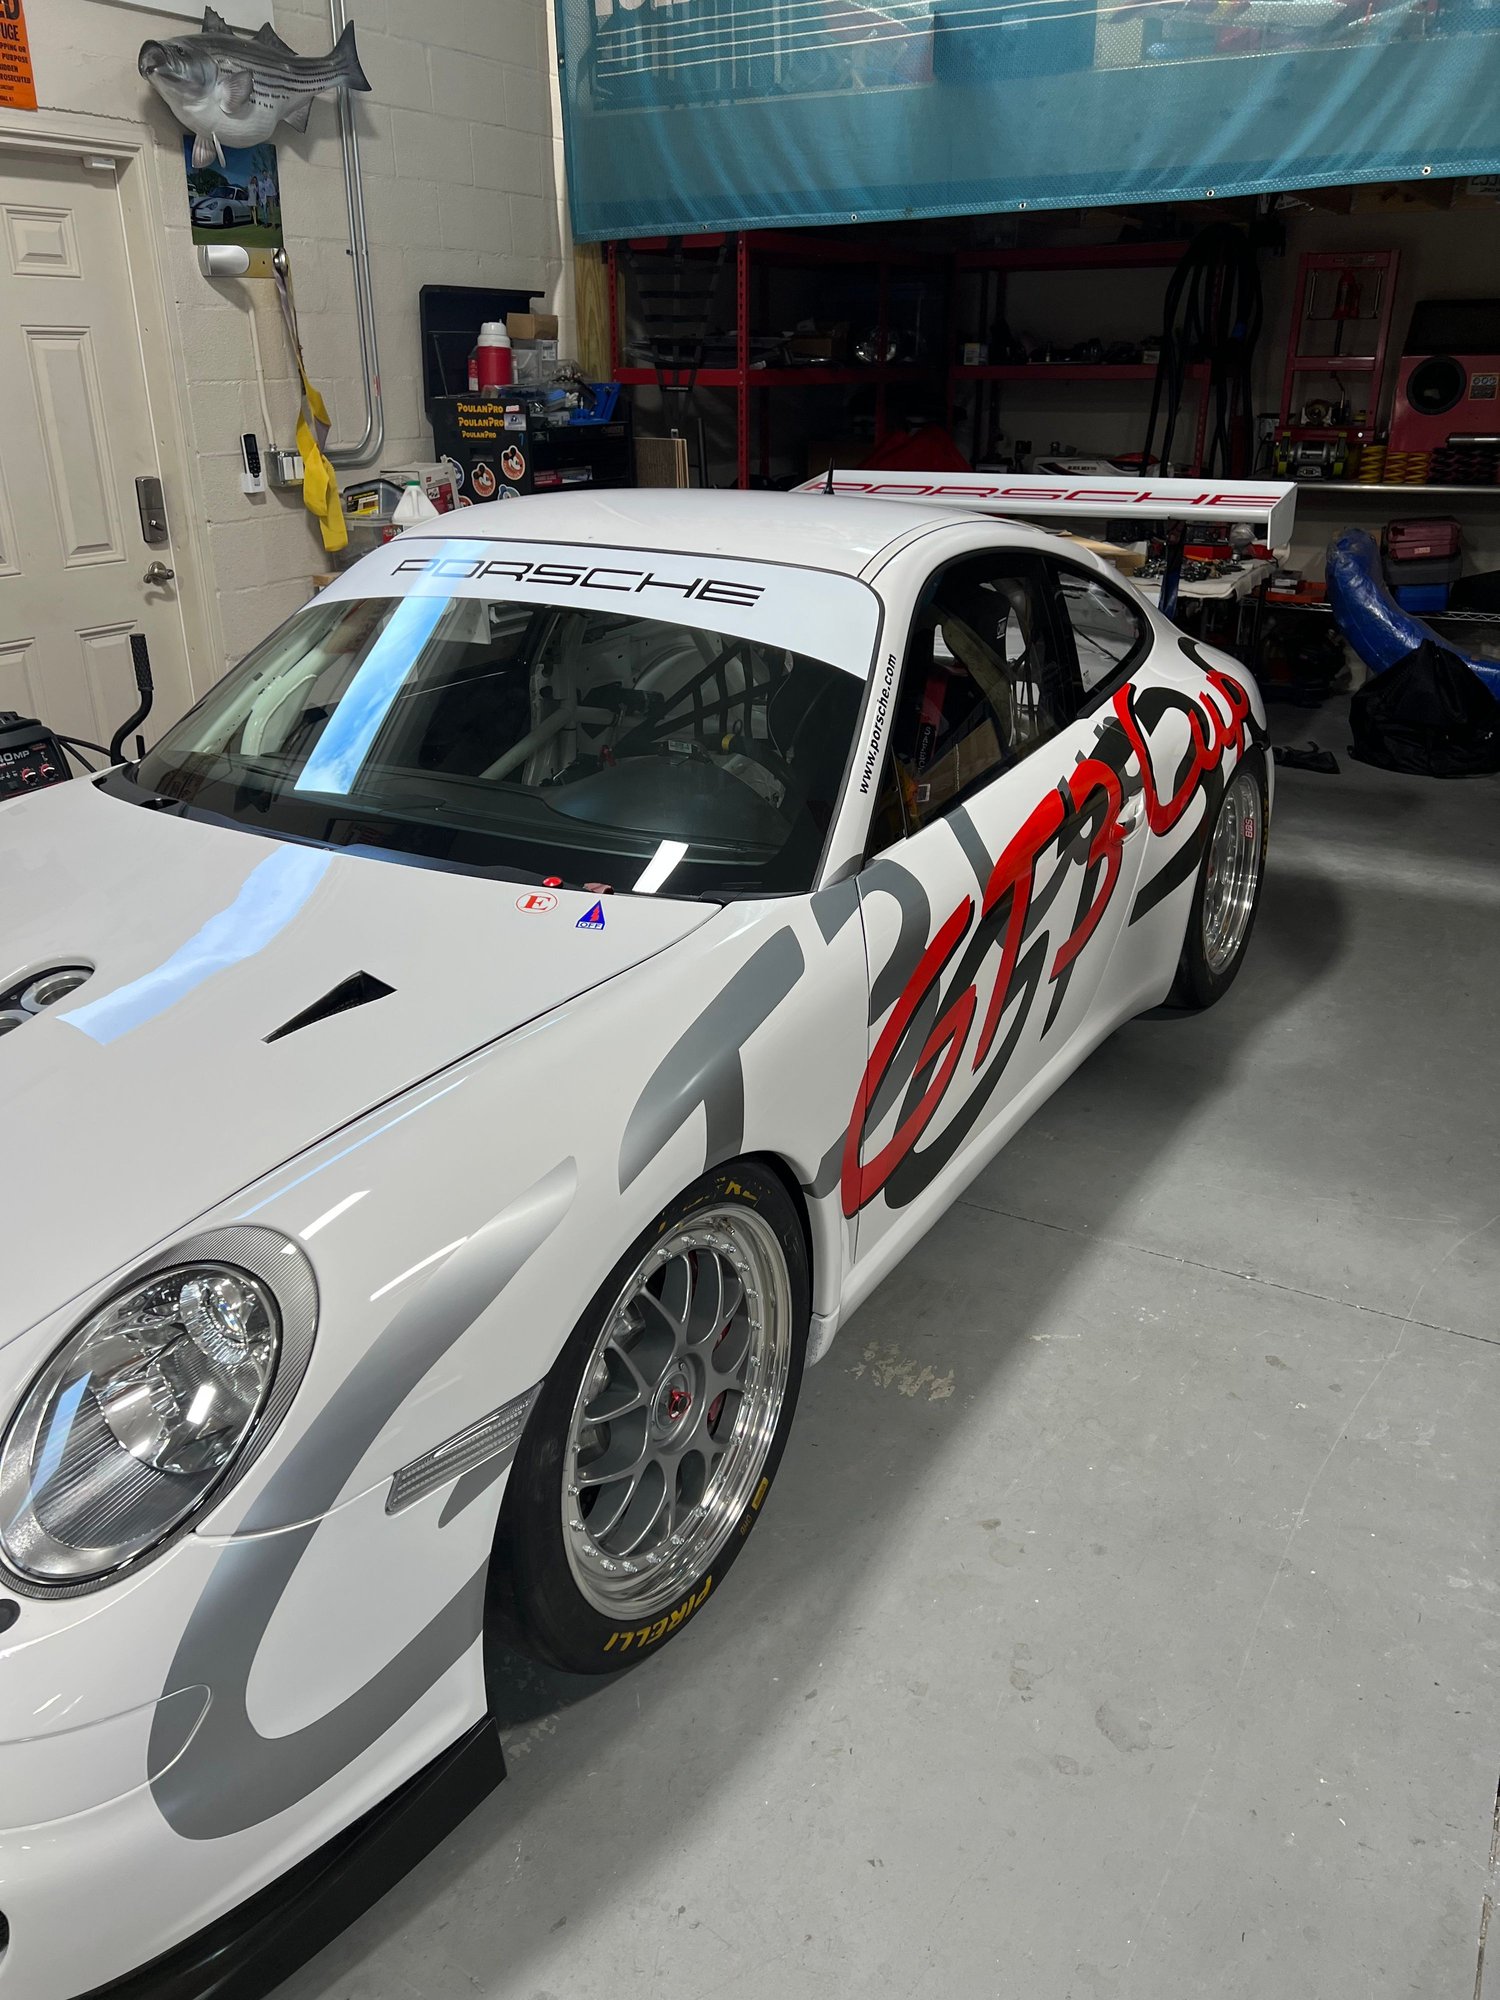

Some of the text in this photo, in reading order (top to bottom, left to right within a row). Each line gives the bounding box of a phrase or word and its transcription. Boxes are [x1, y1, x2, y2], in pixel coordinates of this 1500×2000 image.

[804, 482, 1282, 507] PORSCHE
[391, 558, 766, 607] PORSCHE
[859, 653, 897, 795] www.porsche.com
[1112, 669, 1249, 836] Cup
[1245, 819, 1254, 839] BBS
[524, 894, 551, 911] E
[579, 921, 603, 929] OFF
[603, 1575, 712, 1651] PIRELLI
